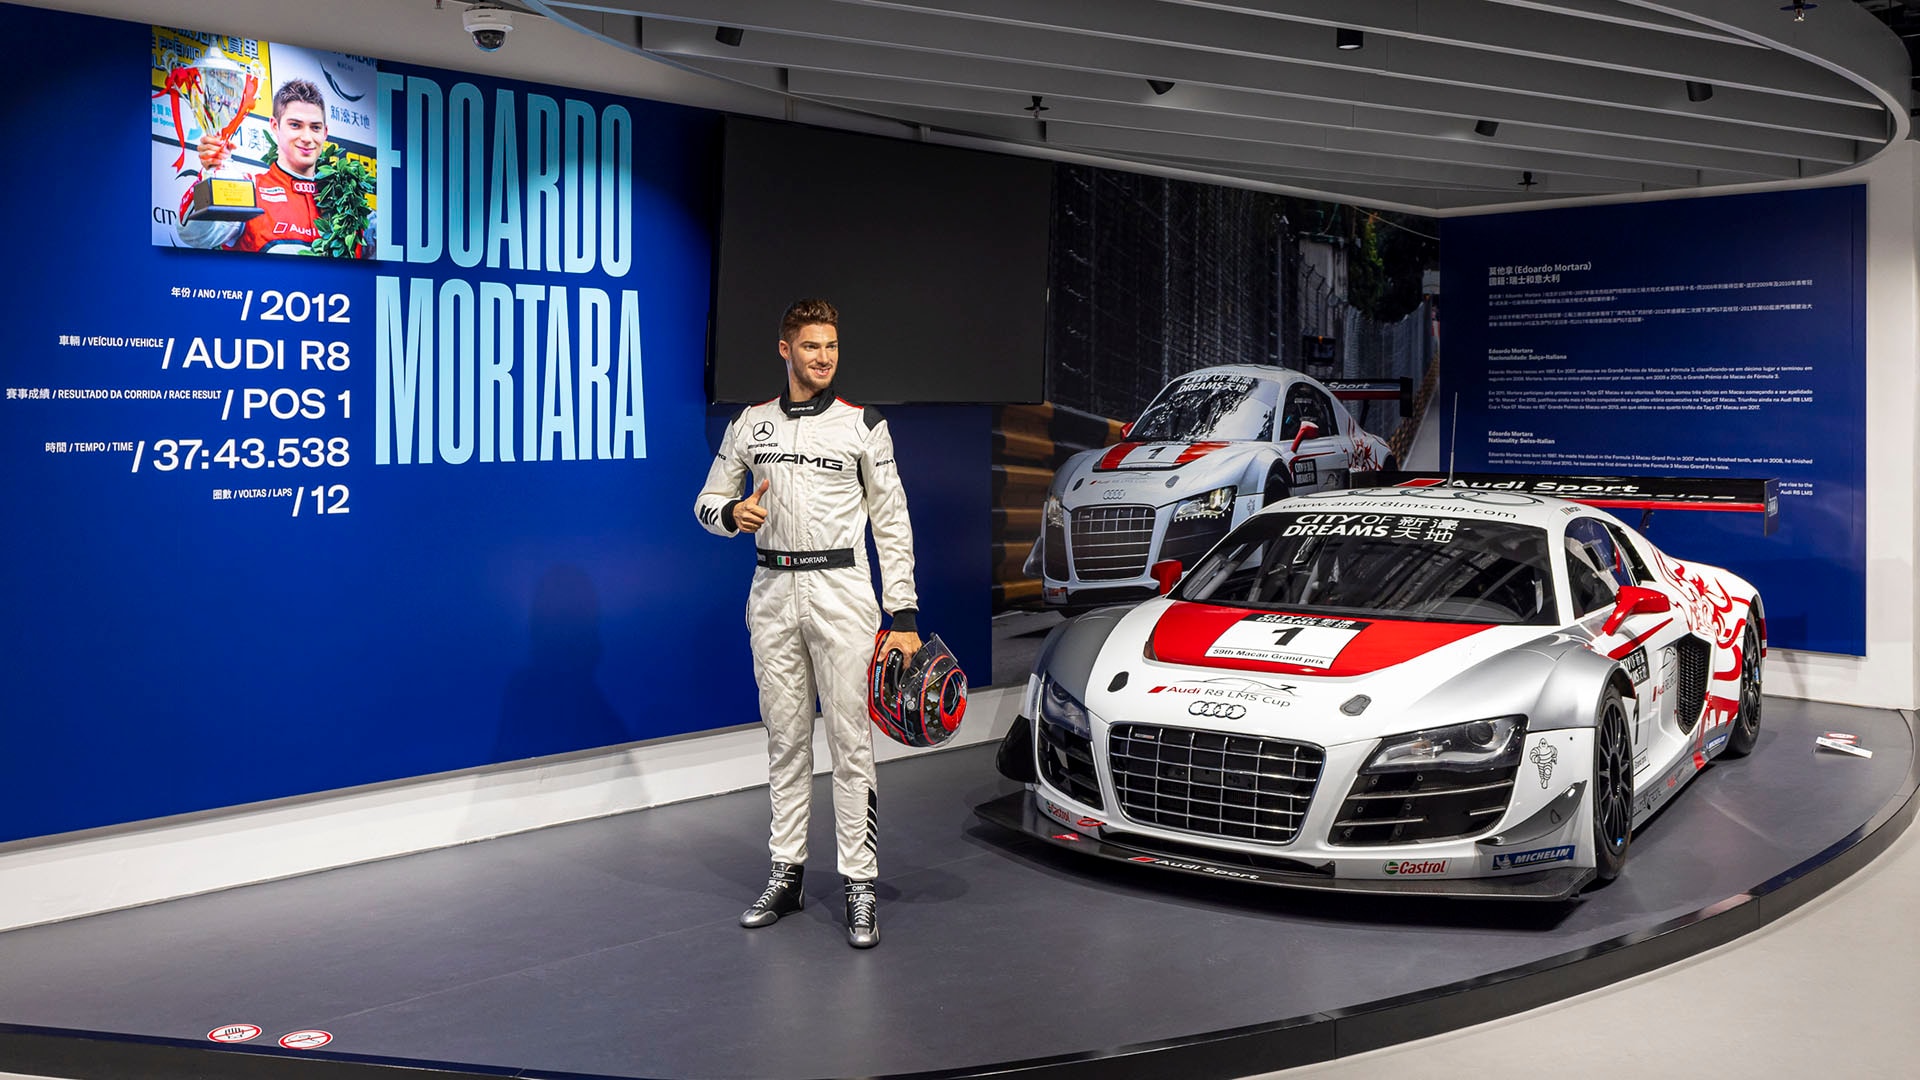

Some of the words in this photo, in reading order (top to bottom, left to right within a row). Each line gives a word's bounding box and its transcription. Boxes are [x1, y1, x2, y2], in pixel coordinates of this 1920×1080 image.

[376, 70, 632, 278] EDOARDO
[290, 224, 316, 236] Audi
[171, 287, 190, 297] 年份
[198, 289, 215, 298] ANO
[222, 290, 242, 299] YEAR
[261, 291, 350, 323] 2012
[88, 336, 123, 346] VEÍCULO
[130, 338, 163, 347] VEHICLE
[183, 338, 284, 369] AUDI
[301, 341, 350, 371] R8
[376, 275, 647, 465] MORTARA
[58, 390, 108, 399] RESULTADO
[111, 390, 122, 398] DA
[124, 390, 161, 399] CORRIDA
[169, 390, 190, 399] RACE
[192, 390, 221, 399] RESULT
[1177, 381, 1223, 393] DREAMS
[244, 388, 325, 419] POS
[338, 390, 350, 418] 1
[46, 442, 66, 453] 時間
[75, 442, 105, 451] TEMPO
[112, 442, 133, 451] TIME
[154, 437, 349, 471] 37:43.538
[1148, 447, 1166, 460] 1
[777, 453, 843, 472] AMG
[238, 489, 266, 498] VOLTAS
[273, 488, 292, 497] LAPS
[1442, 479, 1525, 490] Audi
[1534, 480, 1640, 494] Sport
[312, 485, 349, 514] 12
[1282, 500, 1517, 519] www.audir8lmscup.com
[1296, 514, 1361, 525] CITY
[1361, 514, 1396, 525] OF
[1398, 516, 1460, 530] 新濠
[1282, 524, 1390, 538] DREAMS
[1391, 528, 1454, 543] 天地
[793, 557, 800, 565] E.
[800, 556, 828, 564] MORTARA
[1271, 627, 1304, 646] 1
[1213, 648, 1234, 656] 59th
[1237, 650, 1268, 659] Macau
[1271, 653, 1302, 662] Grand
[1304, 656, 1325, 667] prix
[1167, 686, 1200, 694] Audi
[1204, 688, 1224, 696] R8
[1227, 690, 1258, 701] LMS
[1262, 695, 1291, 708] Cup
[1514, 847, 1570, 864] MICHELIN
[1155, 858, 1199, 870] Audi
[1202, 866, 1259, 880] Sport
[1399, 860, 1447, 875] Castrol
